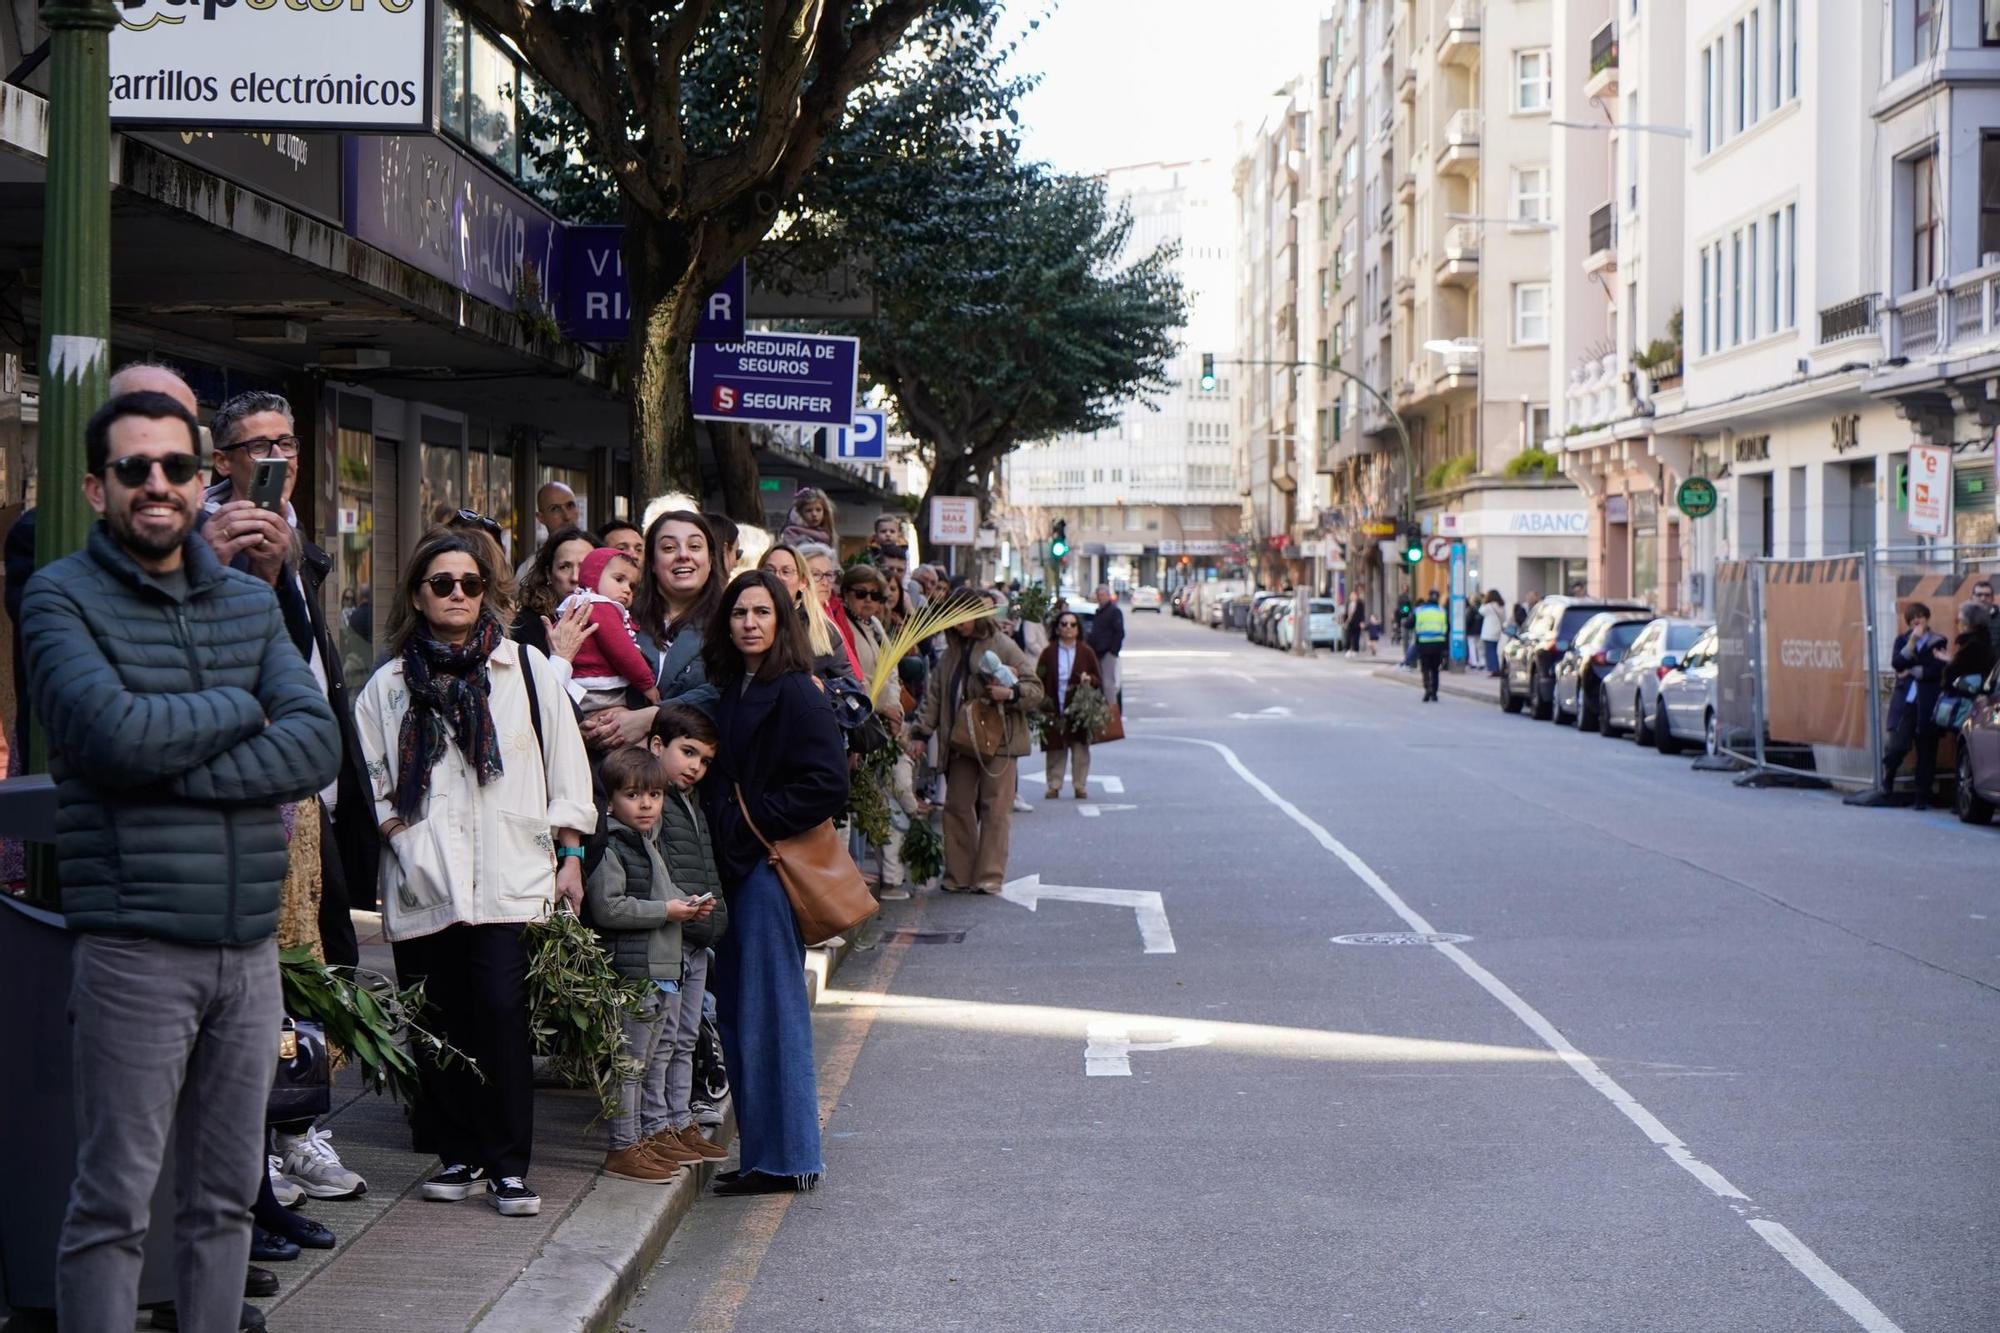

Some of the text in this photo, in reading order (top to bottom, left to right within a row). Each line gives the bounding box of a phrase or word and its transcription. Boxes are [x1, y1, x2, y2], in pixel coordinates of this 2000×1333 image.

[230, 72, 416, 106] electrónicos
[715, 341, 835, 359] CORREDURÍA DE
[738, 357, 809, 375] SEGUROS
[742, 392, 832, 413] SEGURFER
[844, 415, 878, 456] P
